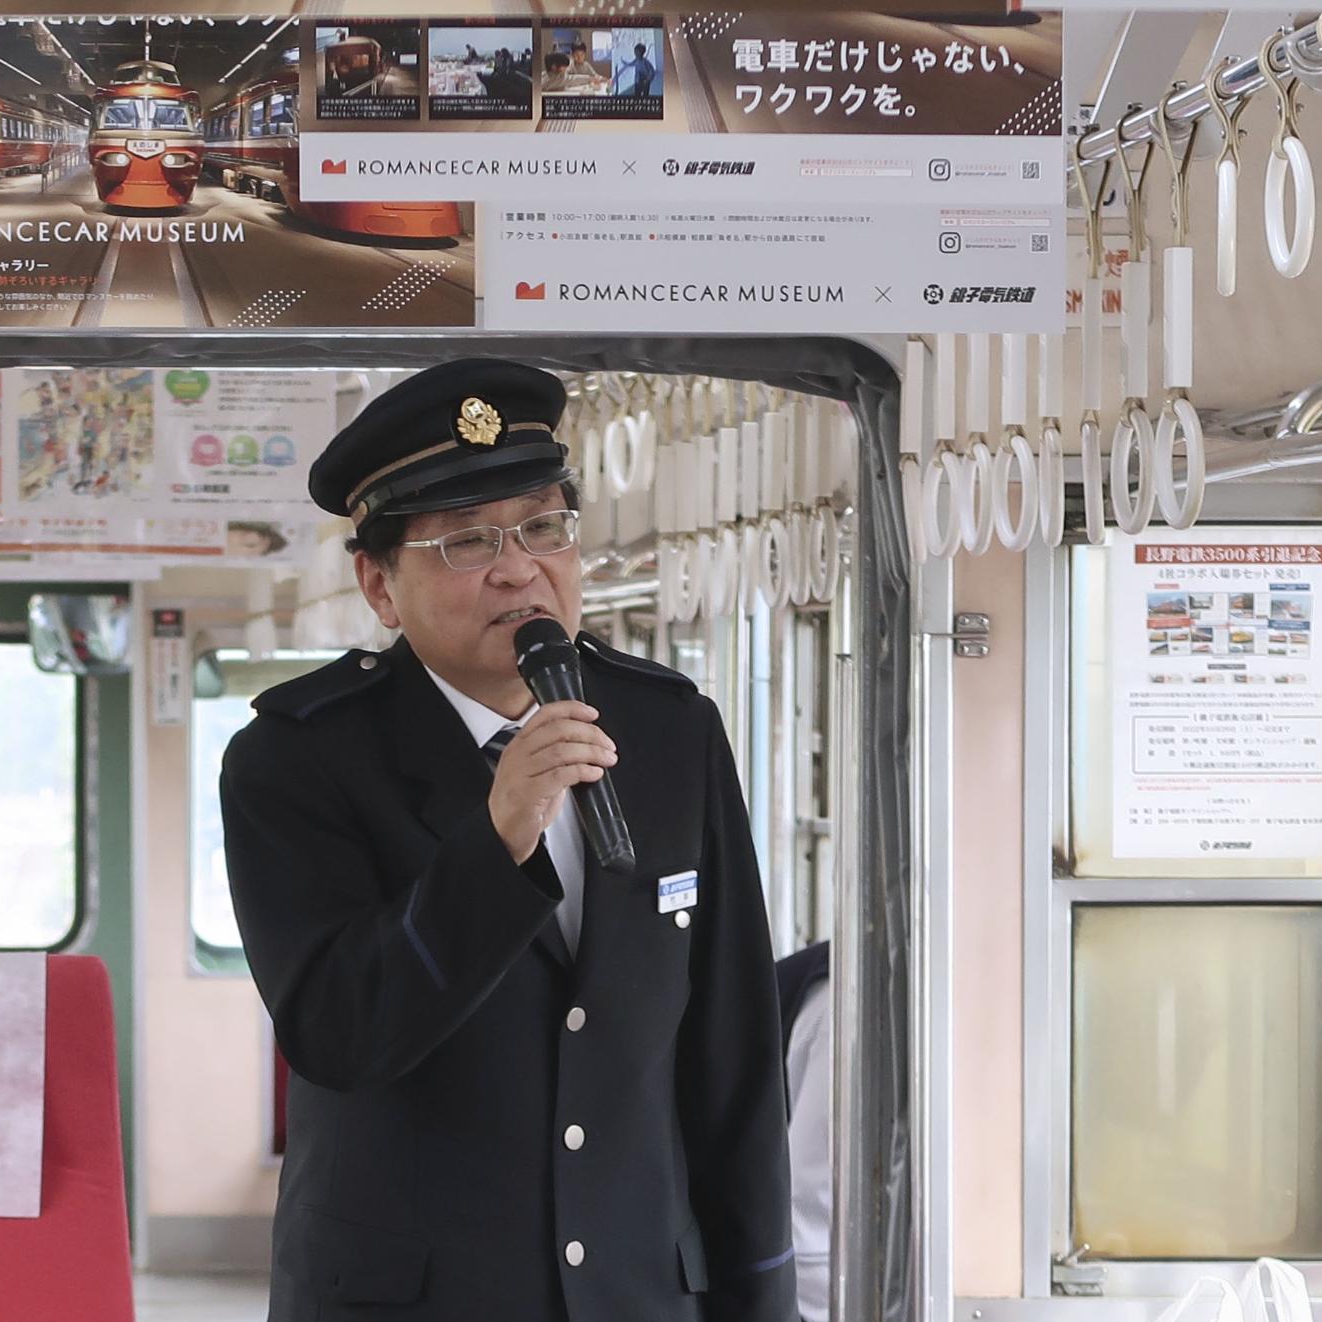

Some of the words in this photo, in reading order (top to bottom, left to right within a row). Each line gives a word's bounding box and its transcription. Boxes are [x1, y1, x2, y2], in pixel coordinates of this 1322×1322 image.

[732, 38, 1027, 76] 電車だけじゃない、
[734, 82, 918, 118] ワクワクを。
[358, 159, 500, 175] ROMANCECAR
[508, 159, 597, 175] MUSEUM
[684, 160, 756, 176] 銚子電気鉄道
[120, 222, 245, 242] MUSEUM
[505, 231, 546, 241] アクセス
[559, 284, 729, 302] ROMANCECAR
[738, 284, 844, 302] MUSEUM
[948, 286, 1037, 304] 銚子電気鉄道
[1144, 546, 1322, 564] 長野電鉄3500系引退記念
